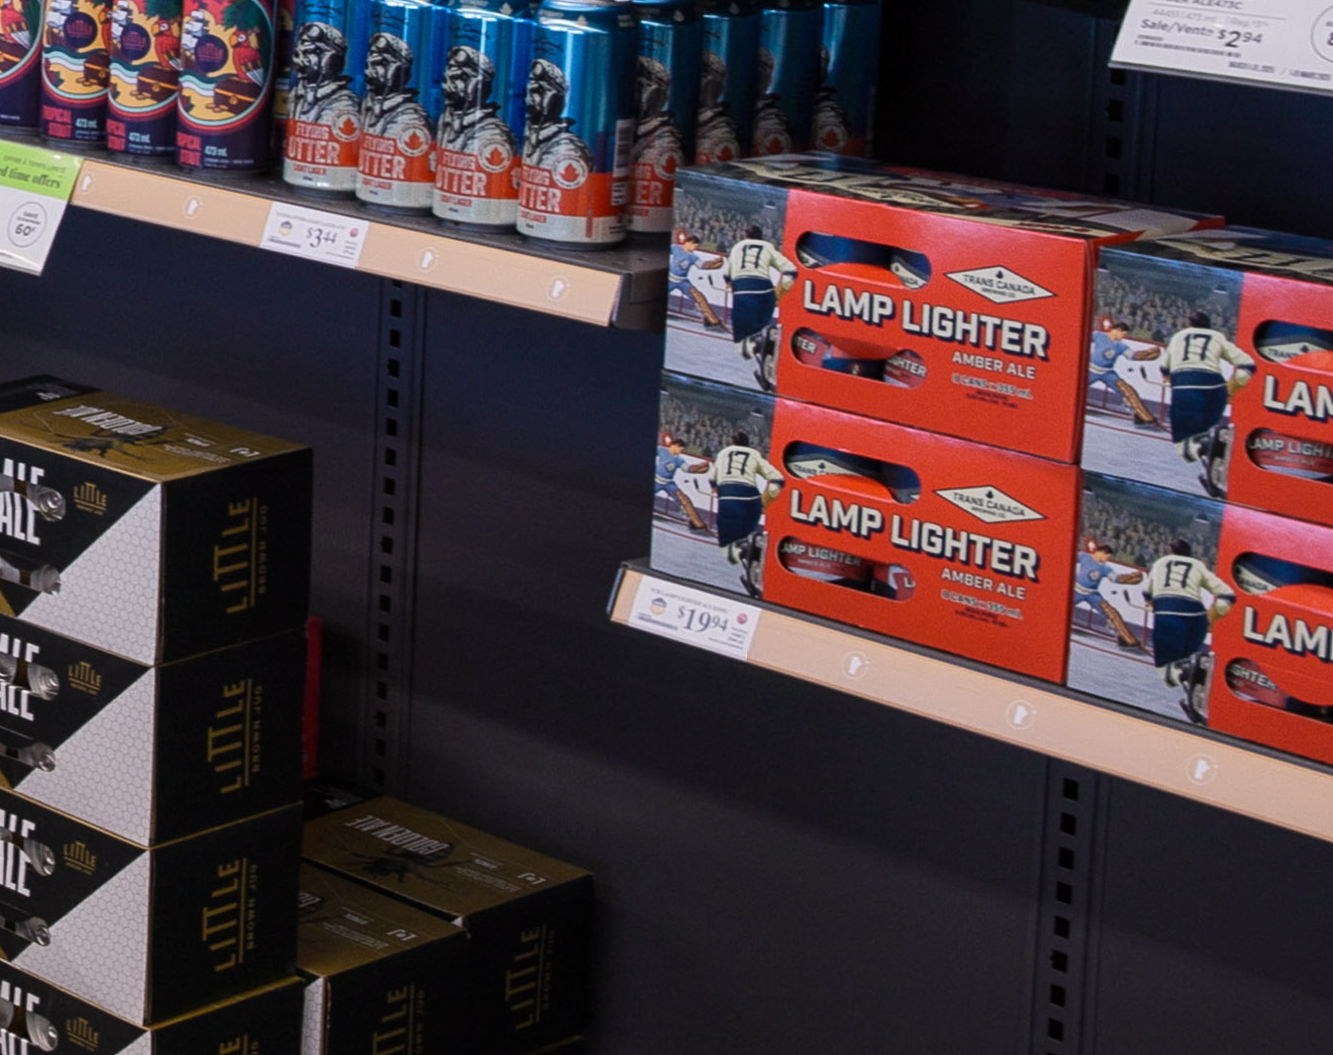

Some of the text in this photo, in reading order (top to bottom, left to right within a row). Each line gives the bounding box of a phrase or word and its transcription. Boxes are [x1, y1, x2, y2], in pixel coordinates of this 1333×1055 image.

[10, 168, 30, 182] time
[32, 173, 60, 189] offers
[739, 243, 764, 271] 17
[963, 275, 1036, 296] TRANS CANADA
[803, 279, 1050, 361] LAMP LIGHTER
[1183, 333, 1212, 362] 17
[952, 351, 1036, 379] AMBER ALE
[1263, 374, 1333, 423] LAM
[725, 447, 750, 476] 17
[952, 492, 1026, 517] TRANS CANADA
[790, 489, 1040, 583] LAMP LIGHTER
[212, 497, 251, 615] LITTLE
[941, 568, 1026, 599] AMBER ALE
[1164, 560, 1193, 588] 17
[1242, 606, 1333, 663] LAM
[206, 679, 245, 796] LITTLE
